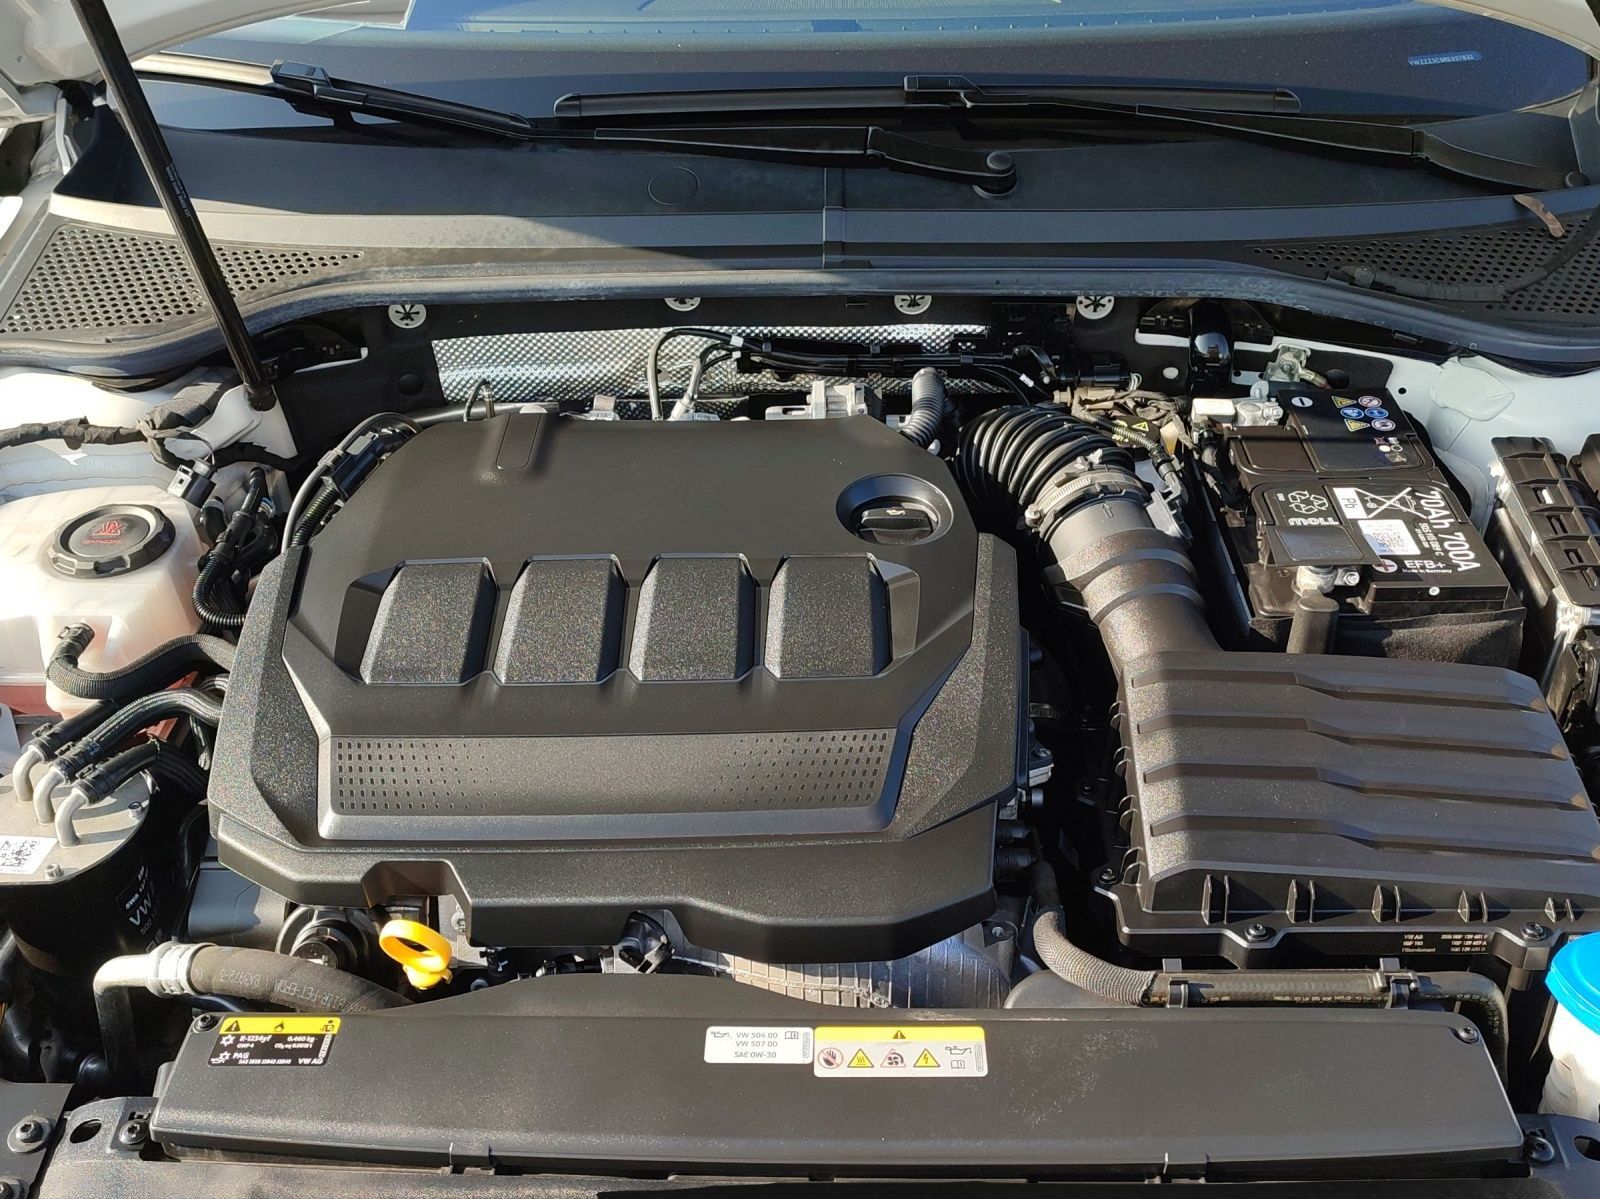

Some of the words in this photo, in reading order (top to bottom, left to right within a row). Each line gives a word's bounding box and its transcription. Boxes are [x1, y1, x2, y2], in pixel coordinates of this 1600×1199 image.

[1342, 497, 1357, 509] Pb
[1415, 490, 1455, 529] 70Ah
[1437, 531, 1480, 572] 700A
[1404, 559, 1446, 569] EFB+
[128, 892, 152, 926] VW
